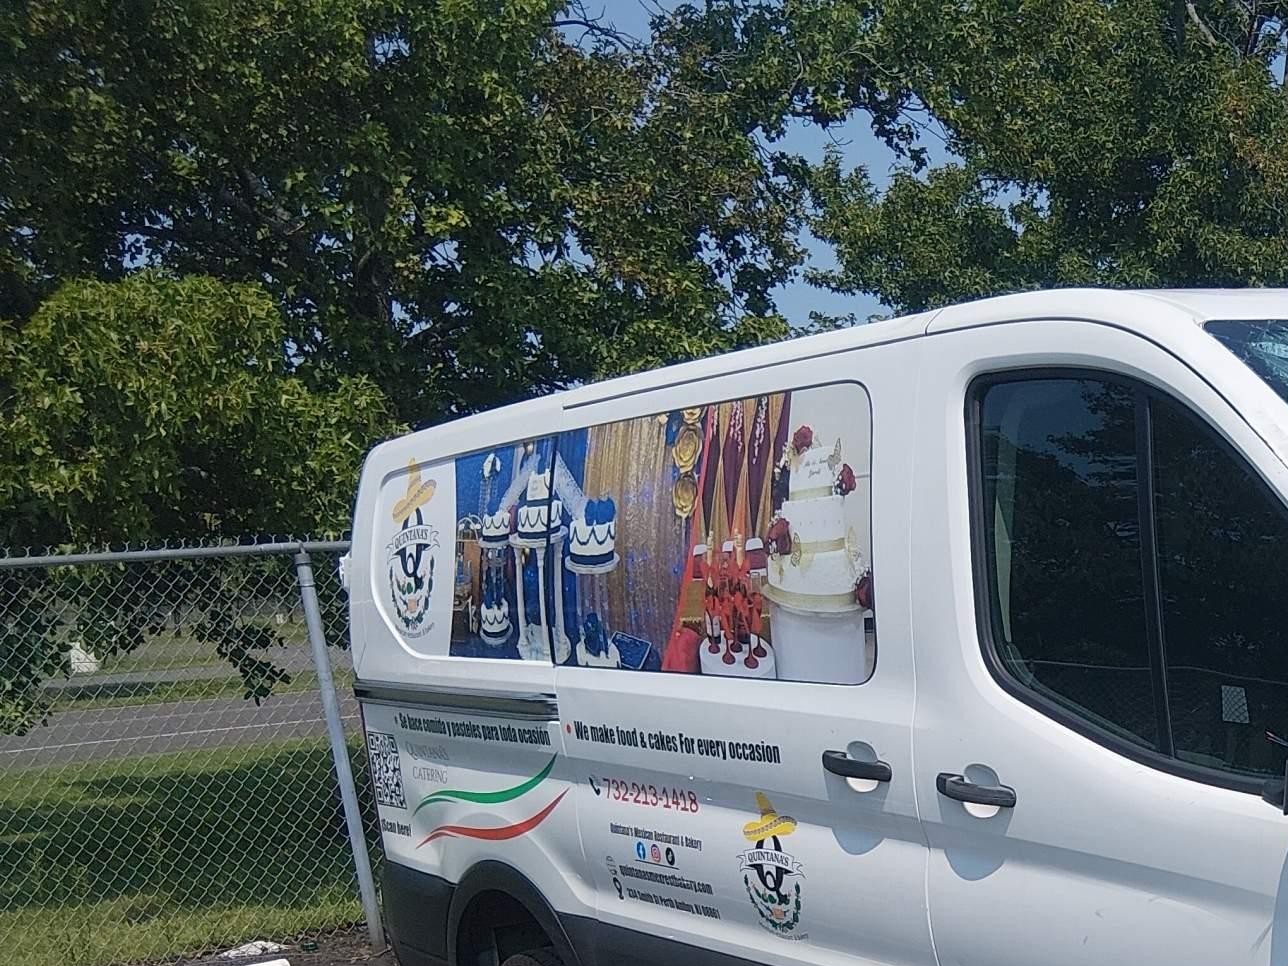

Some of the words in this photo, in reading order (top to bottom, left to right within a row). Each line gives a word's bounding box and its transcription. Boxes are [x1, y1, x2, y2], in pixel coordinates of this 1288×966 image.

[394, 529, 428, 550] QUINTANA'S
[399, 713, 408, 730] Se
[408, 715, 423, 732] hace
[423, 717, 447, 735] comida
[451, 722, 482, 739] pasteles
[482, 728, 499, 743] para
[500, 725, 517, 742] toda
[518, 726, 551, 746] ocasión
[574, 721, 589, 741] We
[590, 724, 616, 745] make
[616, 726, 638, 748] food
[639, 733, 647, 748] &
[648, 731, 678, 753] cakes
[679, 733, 695, 755] For
[697, 739, 727, 760] every
[729, 741, 781, 764] occasion
[412, 766, 448, 785] CATERING
[602, 777, 700, 813] 732-213-1418
[747, 852, 790, 867] QUINTANA'S
